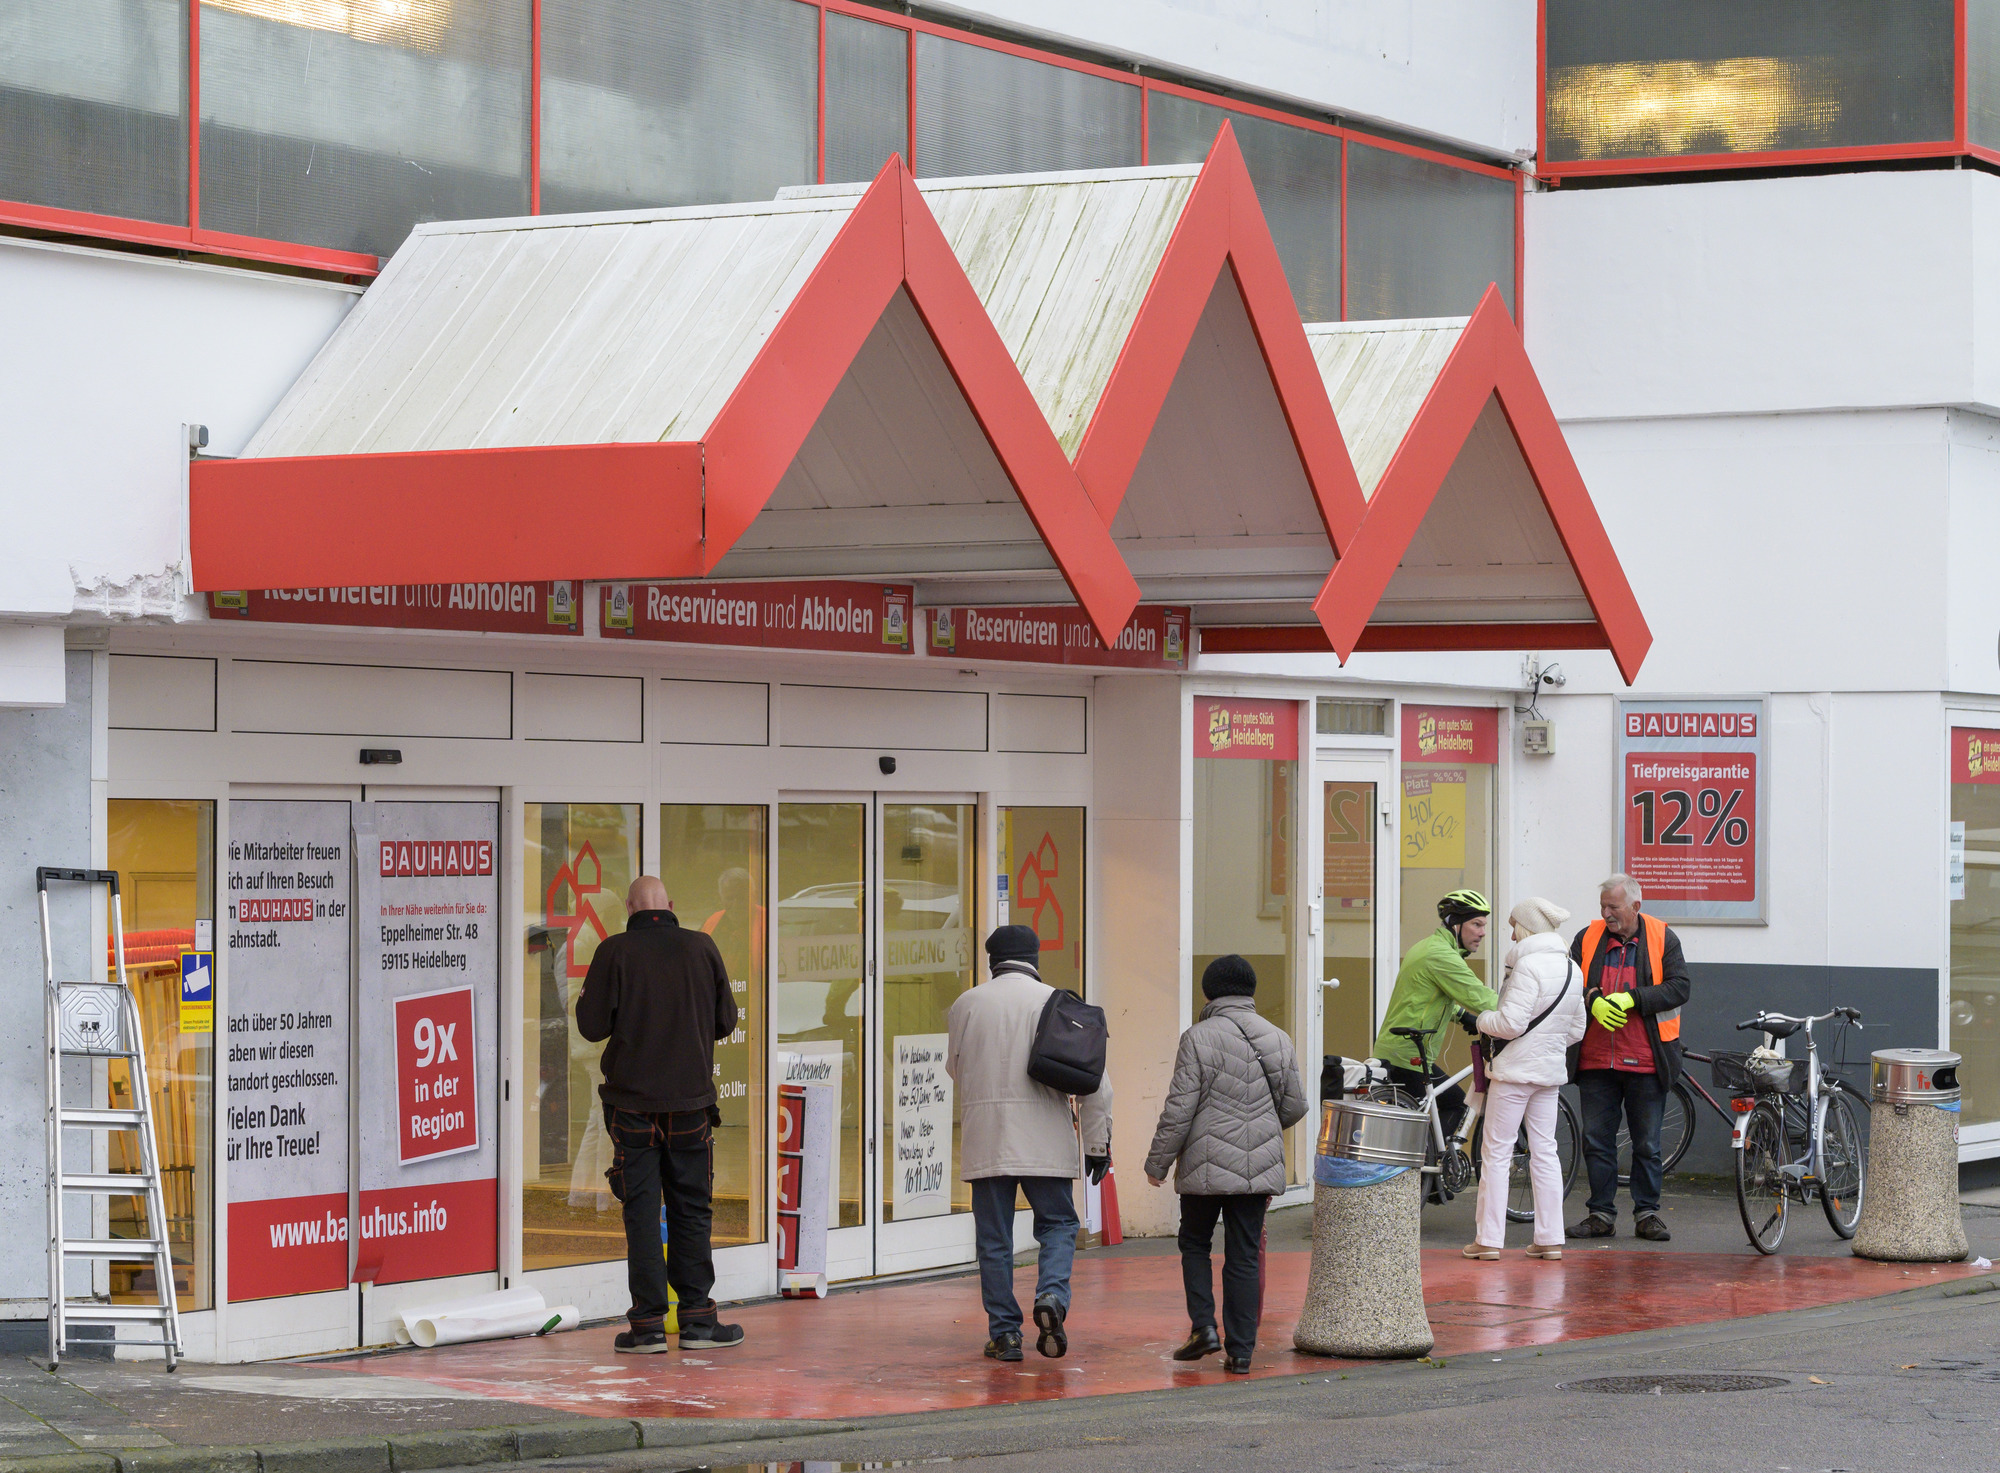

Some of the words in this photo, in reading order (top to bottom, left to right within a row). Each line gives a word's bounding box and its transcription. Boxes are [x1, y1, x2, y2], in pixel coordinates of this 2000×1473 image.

[448, 582, 536, 614] Abholen
[553, 614, 571, 622] ABHOLEN
[647, 586, 758, 627] Reservieren
[764, 594, 796, 629] und
[801, 596, 873, 634] Abholen
[966, 609, 1058, 646] Reservieren
[1064, 623, 1090, 647] und
[1209, 709, 1231, 745] 50
[1233, 711, 1242, 724] ein
[1243, 712, 1258, 727] gutes
[1259, 711, 1274, 725] Stück
[1438, 718, 1446, 730] ein
[1447, 719, 1459, 733] gutes
[1460, 719, 1473, 731] Stück
[1627, 714, 1755, 735] BAUHAUS
[1212, 738, 1231, 752] Jahren
[1233, 728, 1274, 750] Heidelberg
[1438, 734, 1473, 754] Heidelberg
[1632, 763, 1749, 782] Tiefpreisgarantie
[1406, 778, 1430, 791] Platz
[1631, 788, 1750, 847] 12%
[244, 842, 304, 861] Mitarbeiter
[307, 842, 341, 861] freuen
[381, 843, 491, 874] BAUHAUS
[246, 871, 265, 890] auf
[267, 871, 294, 890] Ihren
[297, 871, 334, 889] Besuch
[240, 900, 313, 920] BAUHAUS
[316, 899, 326, 918] in
[328, 899, 346, 918] der
[381, 905, 387, 916] In
[389, 904, 404, 916] Ihrer
[405, 904, 422, 915] Nähe
[424, 903, 454, 915] weiterhin
[456, 903, 464, 914] für
[465, 903, 475, 914] Sie
[476, 902, 487, 914] da:
[228, 929, 281, 949] ahnstadt.
[381, 923, 444, 946] Eppelheimer
[446, 923, 463, 940] Str.
[465, 923, 478, 940] 48
[382, 951, 409, 970] 69115
[412, 950, 467, 971] Heidelberg
[799, 945, 859, 973] EINGANG
[887, 939, 946, 967] EINGANG
[252, 1013, 277, 1031] über
[280, 1013, 294, 1030] 50
[297, 1011, 332, 1030] Jahren
[259, 1042, 277, 1060] wir
[280, 1041, 314, 1059] diesen
[413, 1017, 459, 1068] 9x
[786, 1053, 832, 1081] Lieferanten
[272, 1069, 338, 1093] geschlossen.
[415, 1078, 429, 1103] in
[433, 1073, 459, 1099] der
[720, 1083, 729, 1098] 20
[731, 1081, 746, 1097] Uhr
[910, 1087, 919, 1106] 50
[270, 1102, 306, 1127] Dank
[411, 1108, 465, 1140] Region
[246, 1136, 273, 1160] Ihre
[277, 1131, 320, 1158] Treue!
